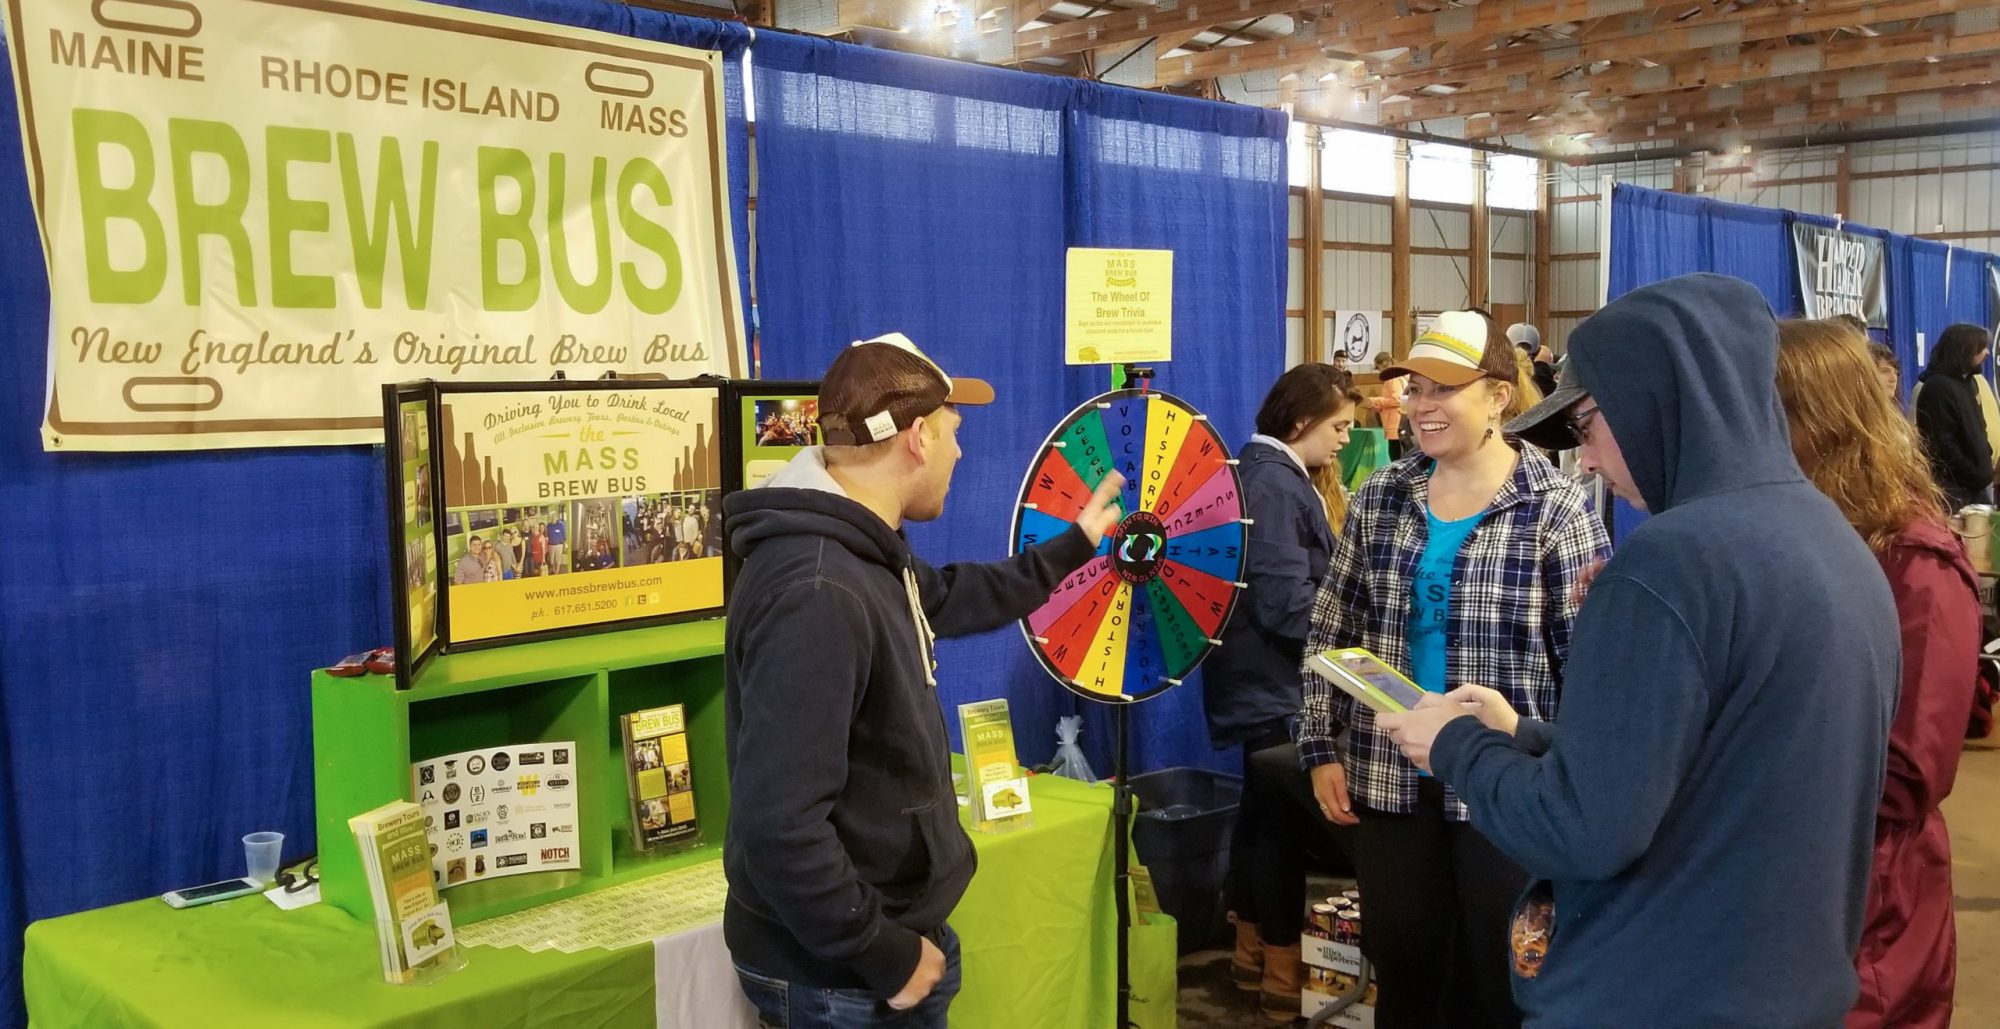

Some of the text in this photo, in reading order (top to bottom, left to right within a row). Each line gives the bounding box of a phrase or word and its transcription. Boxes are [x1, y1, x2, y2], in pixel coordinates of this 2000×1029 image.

[50, 28, 690, 138] MAINE RHODE ISLAND MASS
[71, 107, 684, 316] BREW BUS
[1107, 259, 1136, 269] MASS
[1091, 291, 1150, 302] The Wheel Of
[1096, 307, 1145, 318] Brew Trivia
[71, 328, 711, 375] New England's Original Brew Bus
[483, 393, 691, 430] Driving You to Drink Local
[494, 432, 506, 444] All
[508, 420, 546, 438] Inclusive
[548, 414, 582, 426] Brewery
[616, 412, 645, 425] Parties
[579, 424, 606, 443] the
[543, 446, 640, 477] MASS
[1119, 405, 1137, 492] VOCAB
[1144, 409, 1176, 511] HISTORY
[538, 475, 647, 499] BREW BUS
[1157, 437, 1214, 516] WILD
[1165, 490, 1234, 536] SCIENCE
[1169, 545, 1237, 559] MATH
[525, 575, 662, 601] www.massbrewbus.com
[1053, 560, 1109, 596] IENCE
[1163, 564, 1224, 618] WILD
[554, 599, 618, 616] 617.651.5200
[1052, 580, 1114, 663] WILD
[1094, 585, 1129, 688] HISTORY
[635, 716, 661, 732] BREW
[662, 713, 681, 725] BUS
[977, 730, 1004, 741] MASS
[377, 809, 421, 832] Brewery Tours
[391, 844, 422, 865] MASS
[540, 847, 570, 860] NOTCH
